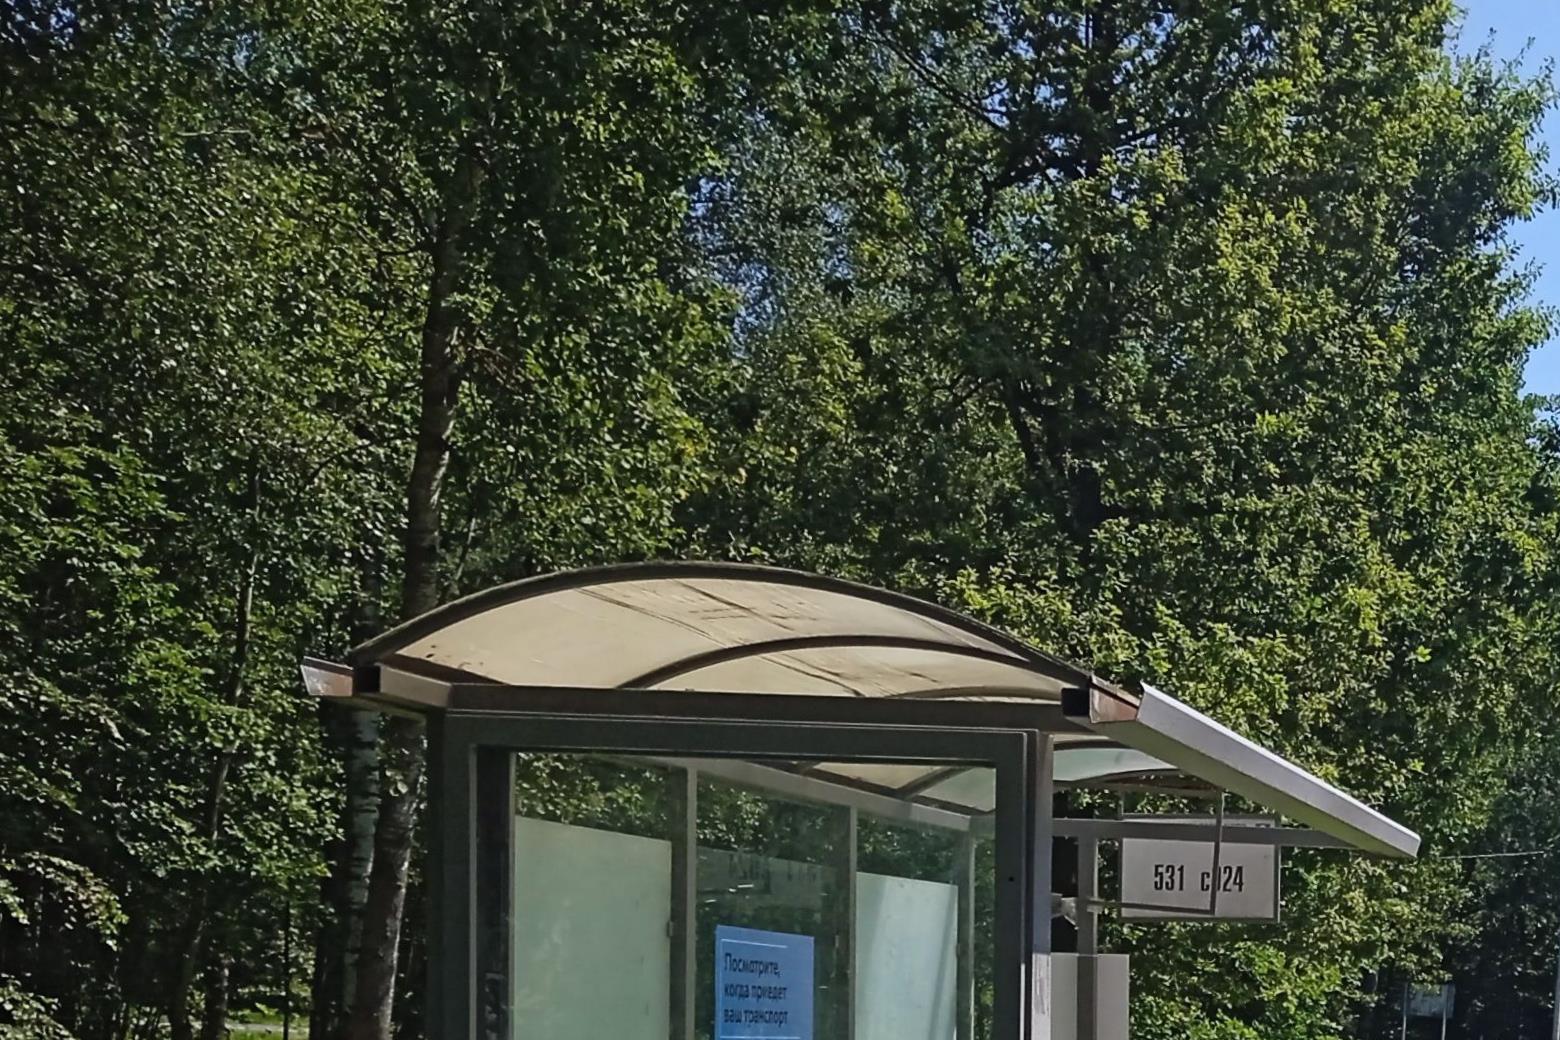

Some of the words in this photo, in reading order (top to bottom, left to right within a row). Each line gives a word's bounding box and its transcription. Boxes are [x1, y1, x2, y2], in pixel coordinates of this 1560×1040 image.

[1154, 864, 1184, 891] 531
[724, 952, 781, 979] Посмотрите,
[724, 983, 750, 1001] когда
[751, 985, 788, 1003] приедет
[724, 1008, 742, 1024] ваш
[743, 1009, 789, 1029] транспорт
